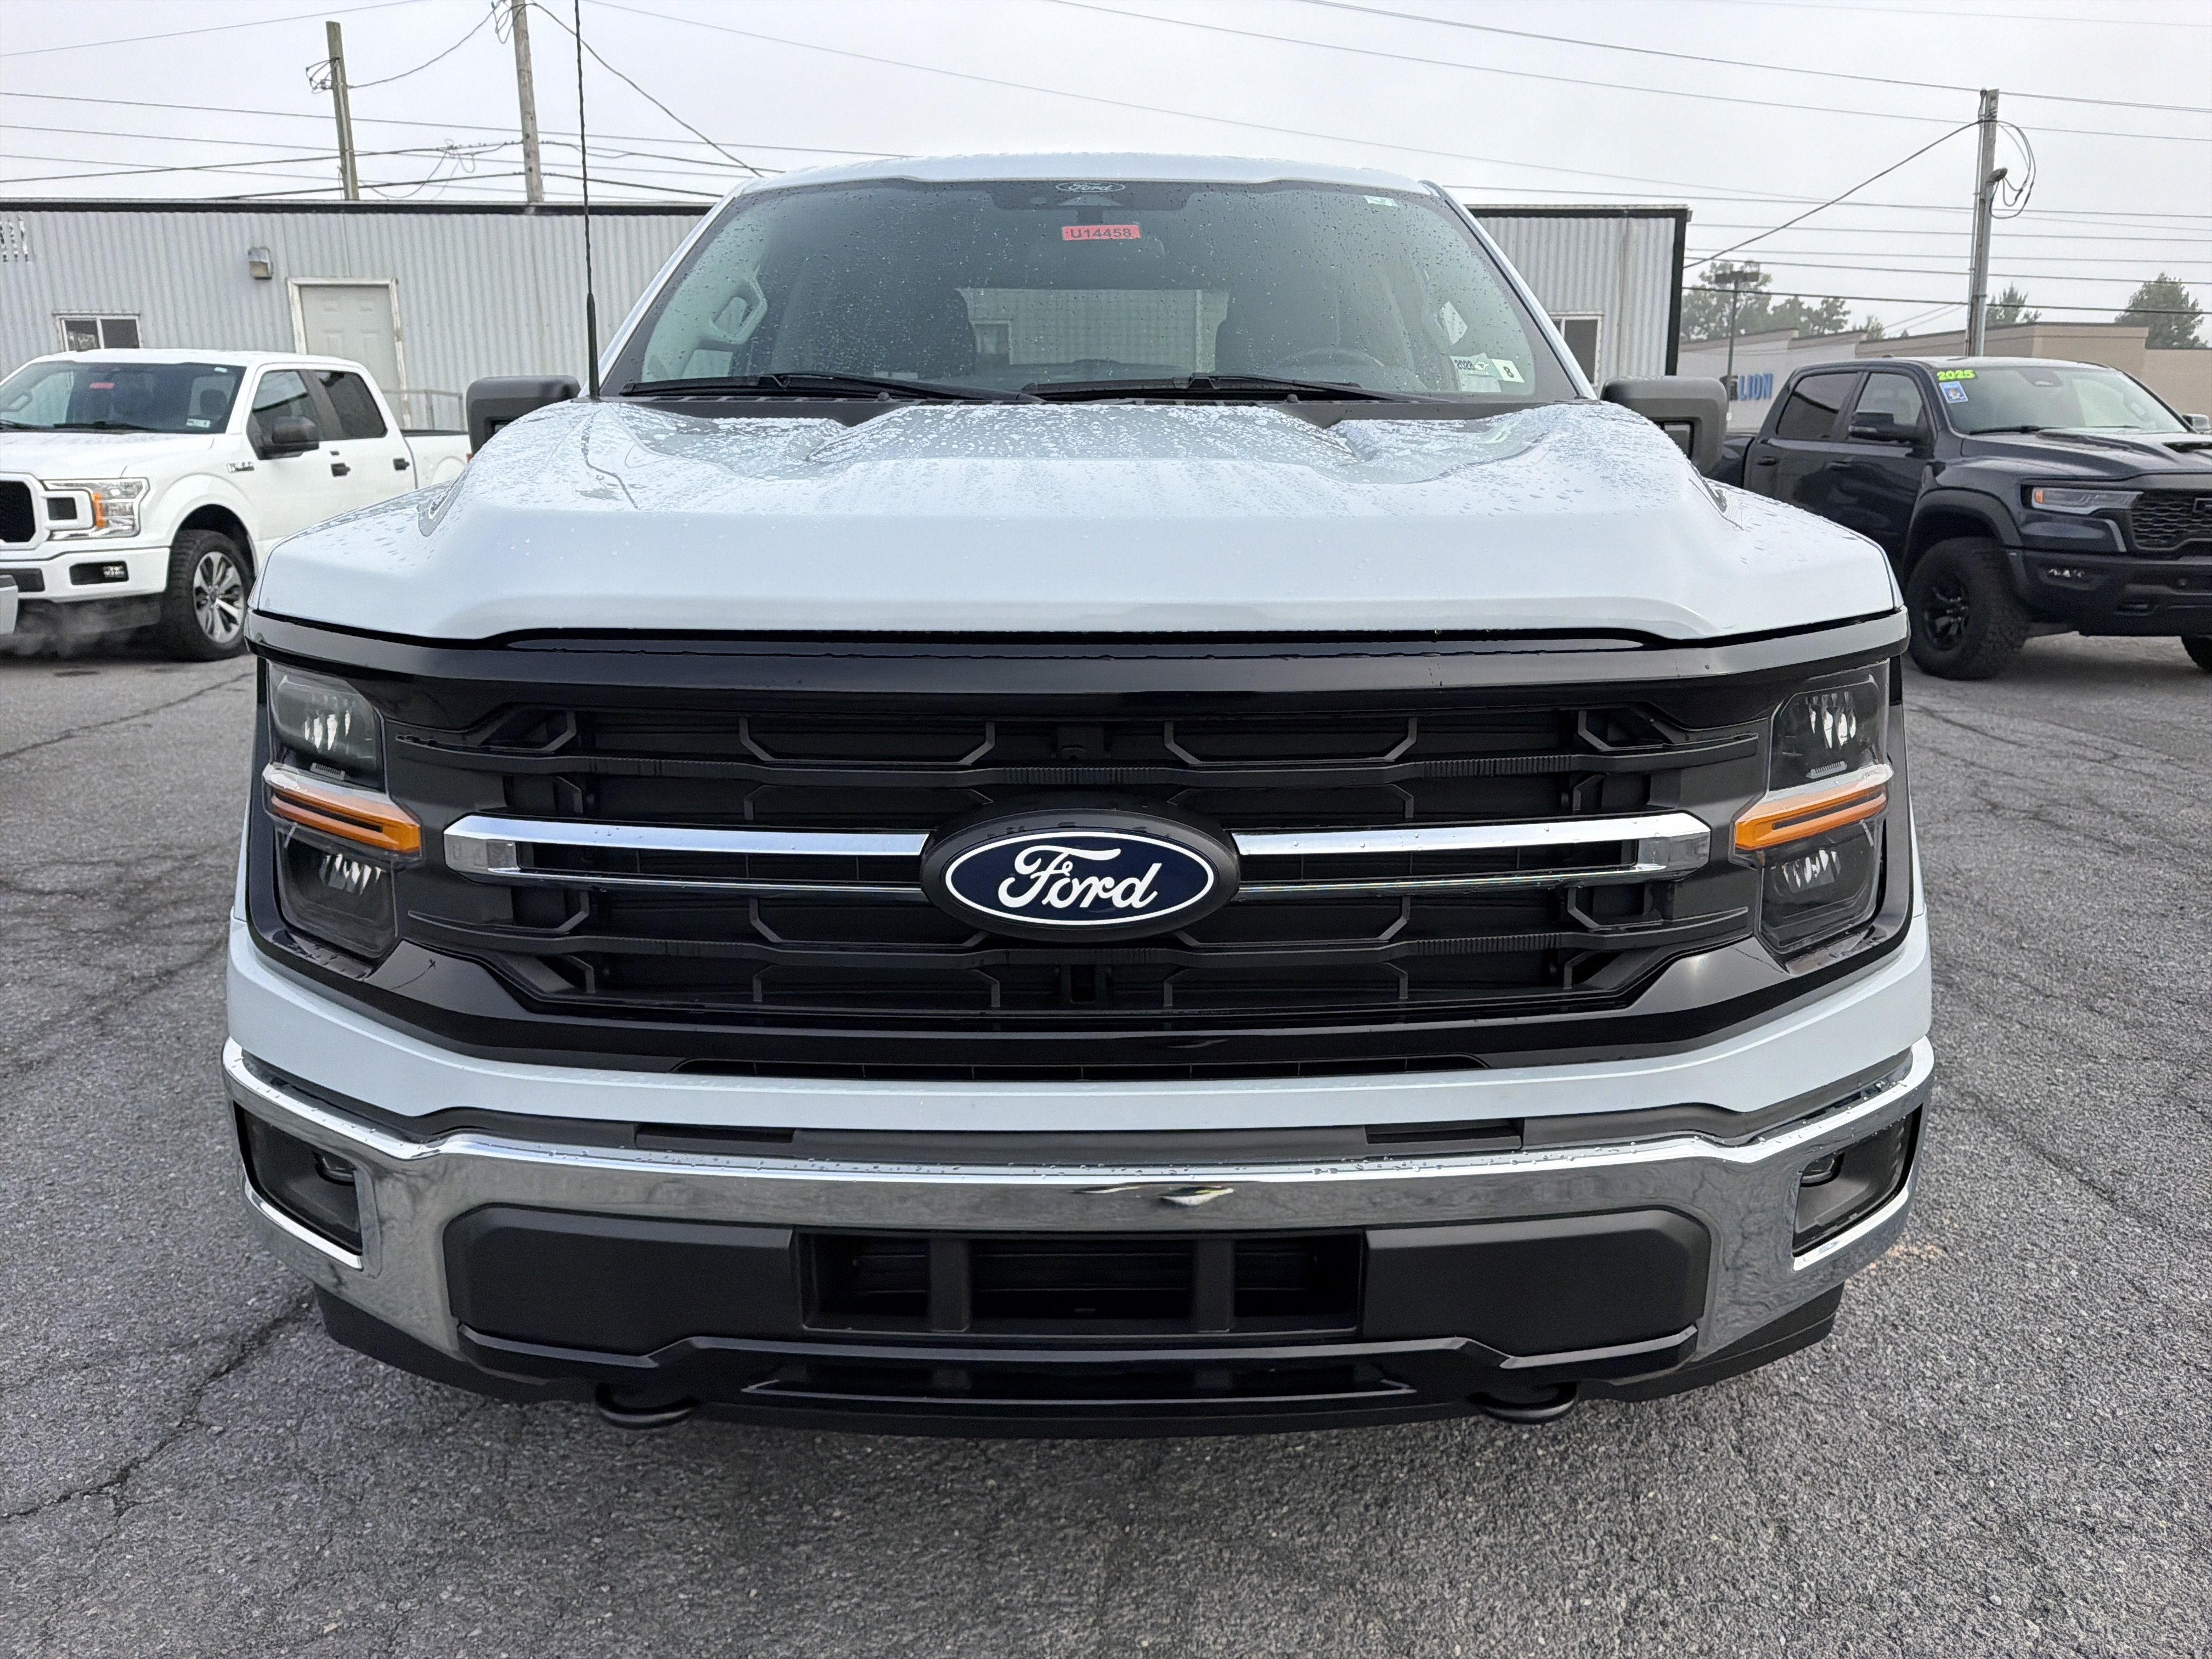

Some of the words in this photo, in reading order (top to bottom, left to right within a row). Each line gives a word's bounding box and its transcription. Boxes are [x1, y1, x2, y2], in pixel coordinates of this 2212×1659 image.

[1068, 182, 1114, 191] Ford
[1071, 228, 1132, 238] U14458
[1503, 366, 1515, 378] 8
[1937, 369, 1975, 381] 2025
[1738, 373, 1773, 400] LION
[998, 845, 1162, 909] Ford
